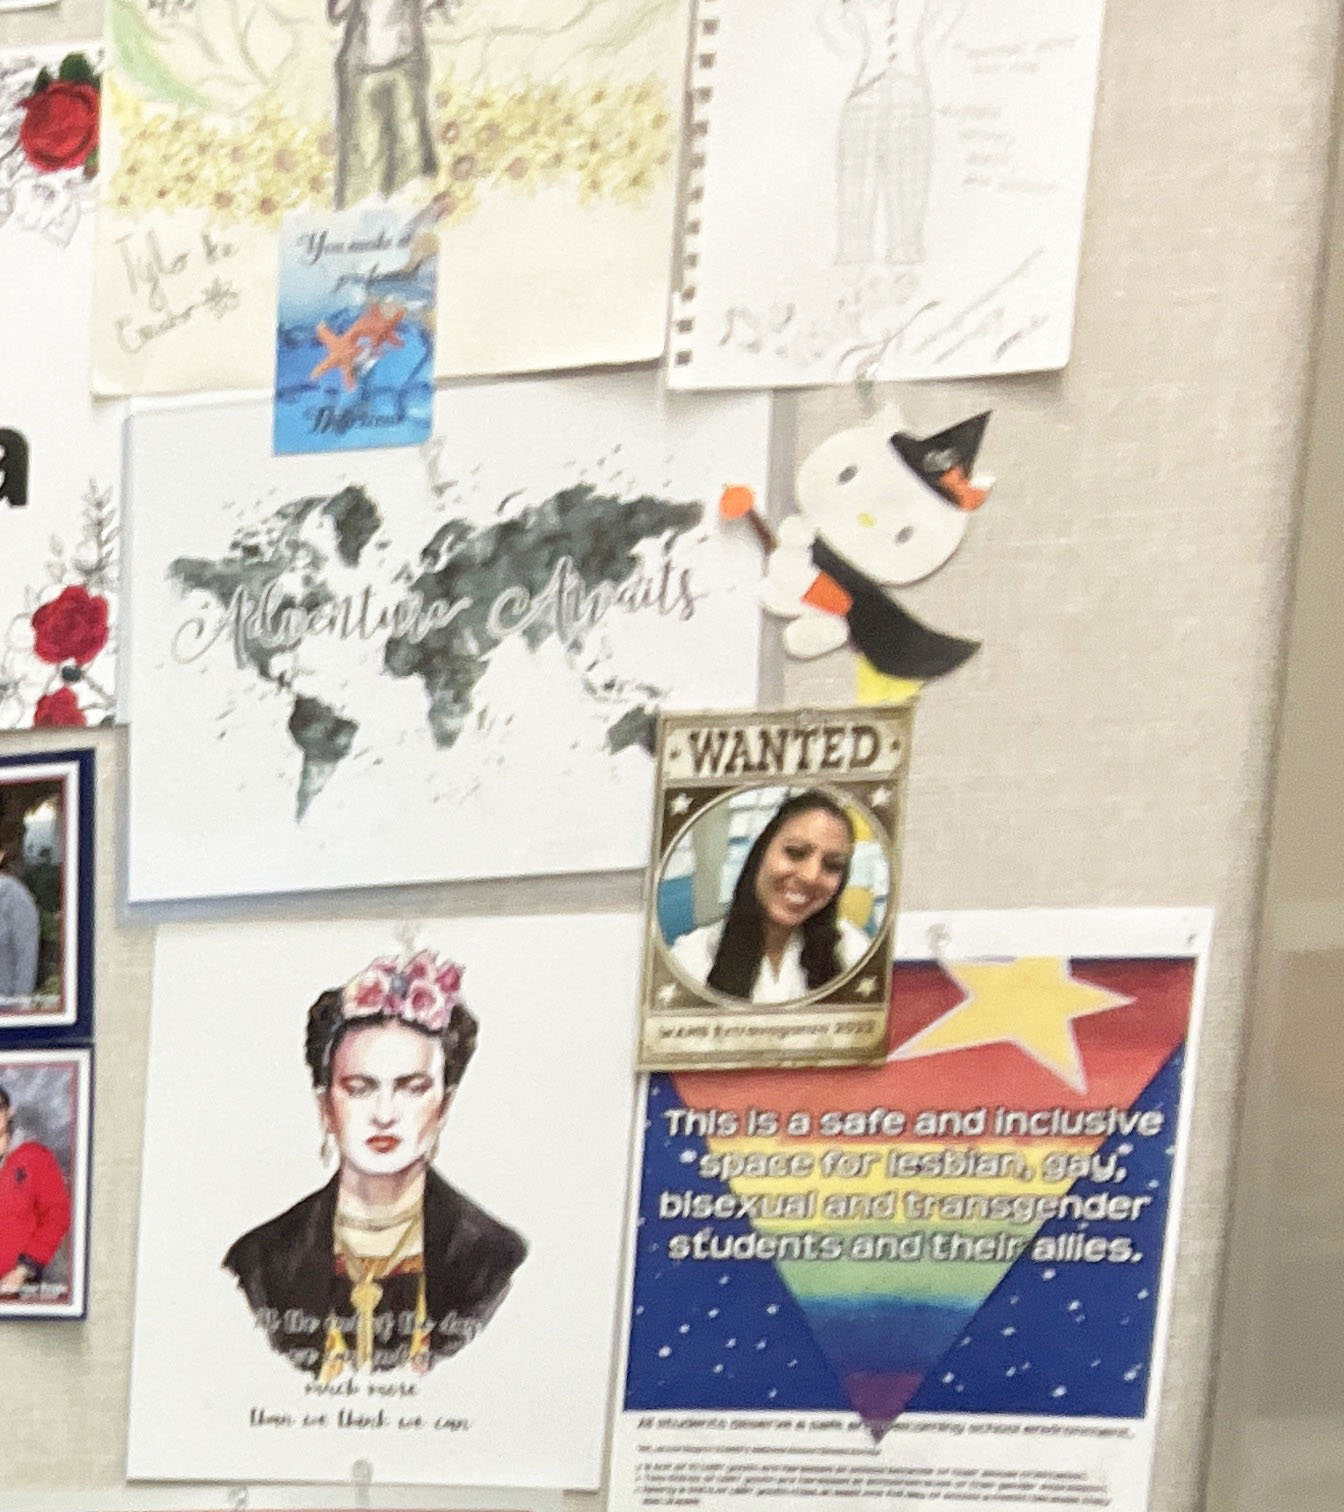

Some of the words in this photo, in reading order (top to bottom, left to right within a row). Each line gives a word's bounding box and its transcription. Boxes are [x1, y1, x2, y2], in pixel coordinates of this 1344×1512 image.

[297, 230, 345, 265] You
[172, 580, 470, 667] Adventure
[489, 556, 707, 642] Awaits
[687, 725, 884, 774] WANTED
[665, 1108, 737, 1137] This
[746, 1109, 778, 1136] is
[787, 1113, 812, 1136] a
[820, 1106, 905, 1136] safe
[913, 1107, 985, 1137] and
[996, 1107, 1165, 1137] inclusive
[698, 1152, 814, 1183] space
[822, 1149, 877, 1178] for
[889, 1150, 1033, 1183] lesbian,
[1043, 1154, 1128, 1185] gay,
[659, 1191, 816, 1219] bisexual
[824, 1192, 896, 1220] and
[905, 1193, 1154, 1224] transgender
[669, 1231, 844, 1260] students
[852, 1233, 922, 1261] and
[929, 1233, 1017, 1261] their
[1032, 1234, 1144, 1263] allies.
[305, 1377, 360, 1397] much
[368, 1380, 419, 1397] more
[250, 1408, 295, 1428] than
[303, 1412, 327, 1428] we
[338, 1408, 389, 1429] think
[398, 1413, 427, 1429] we
